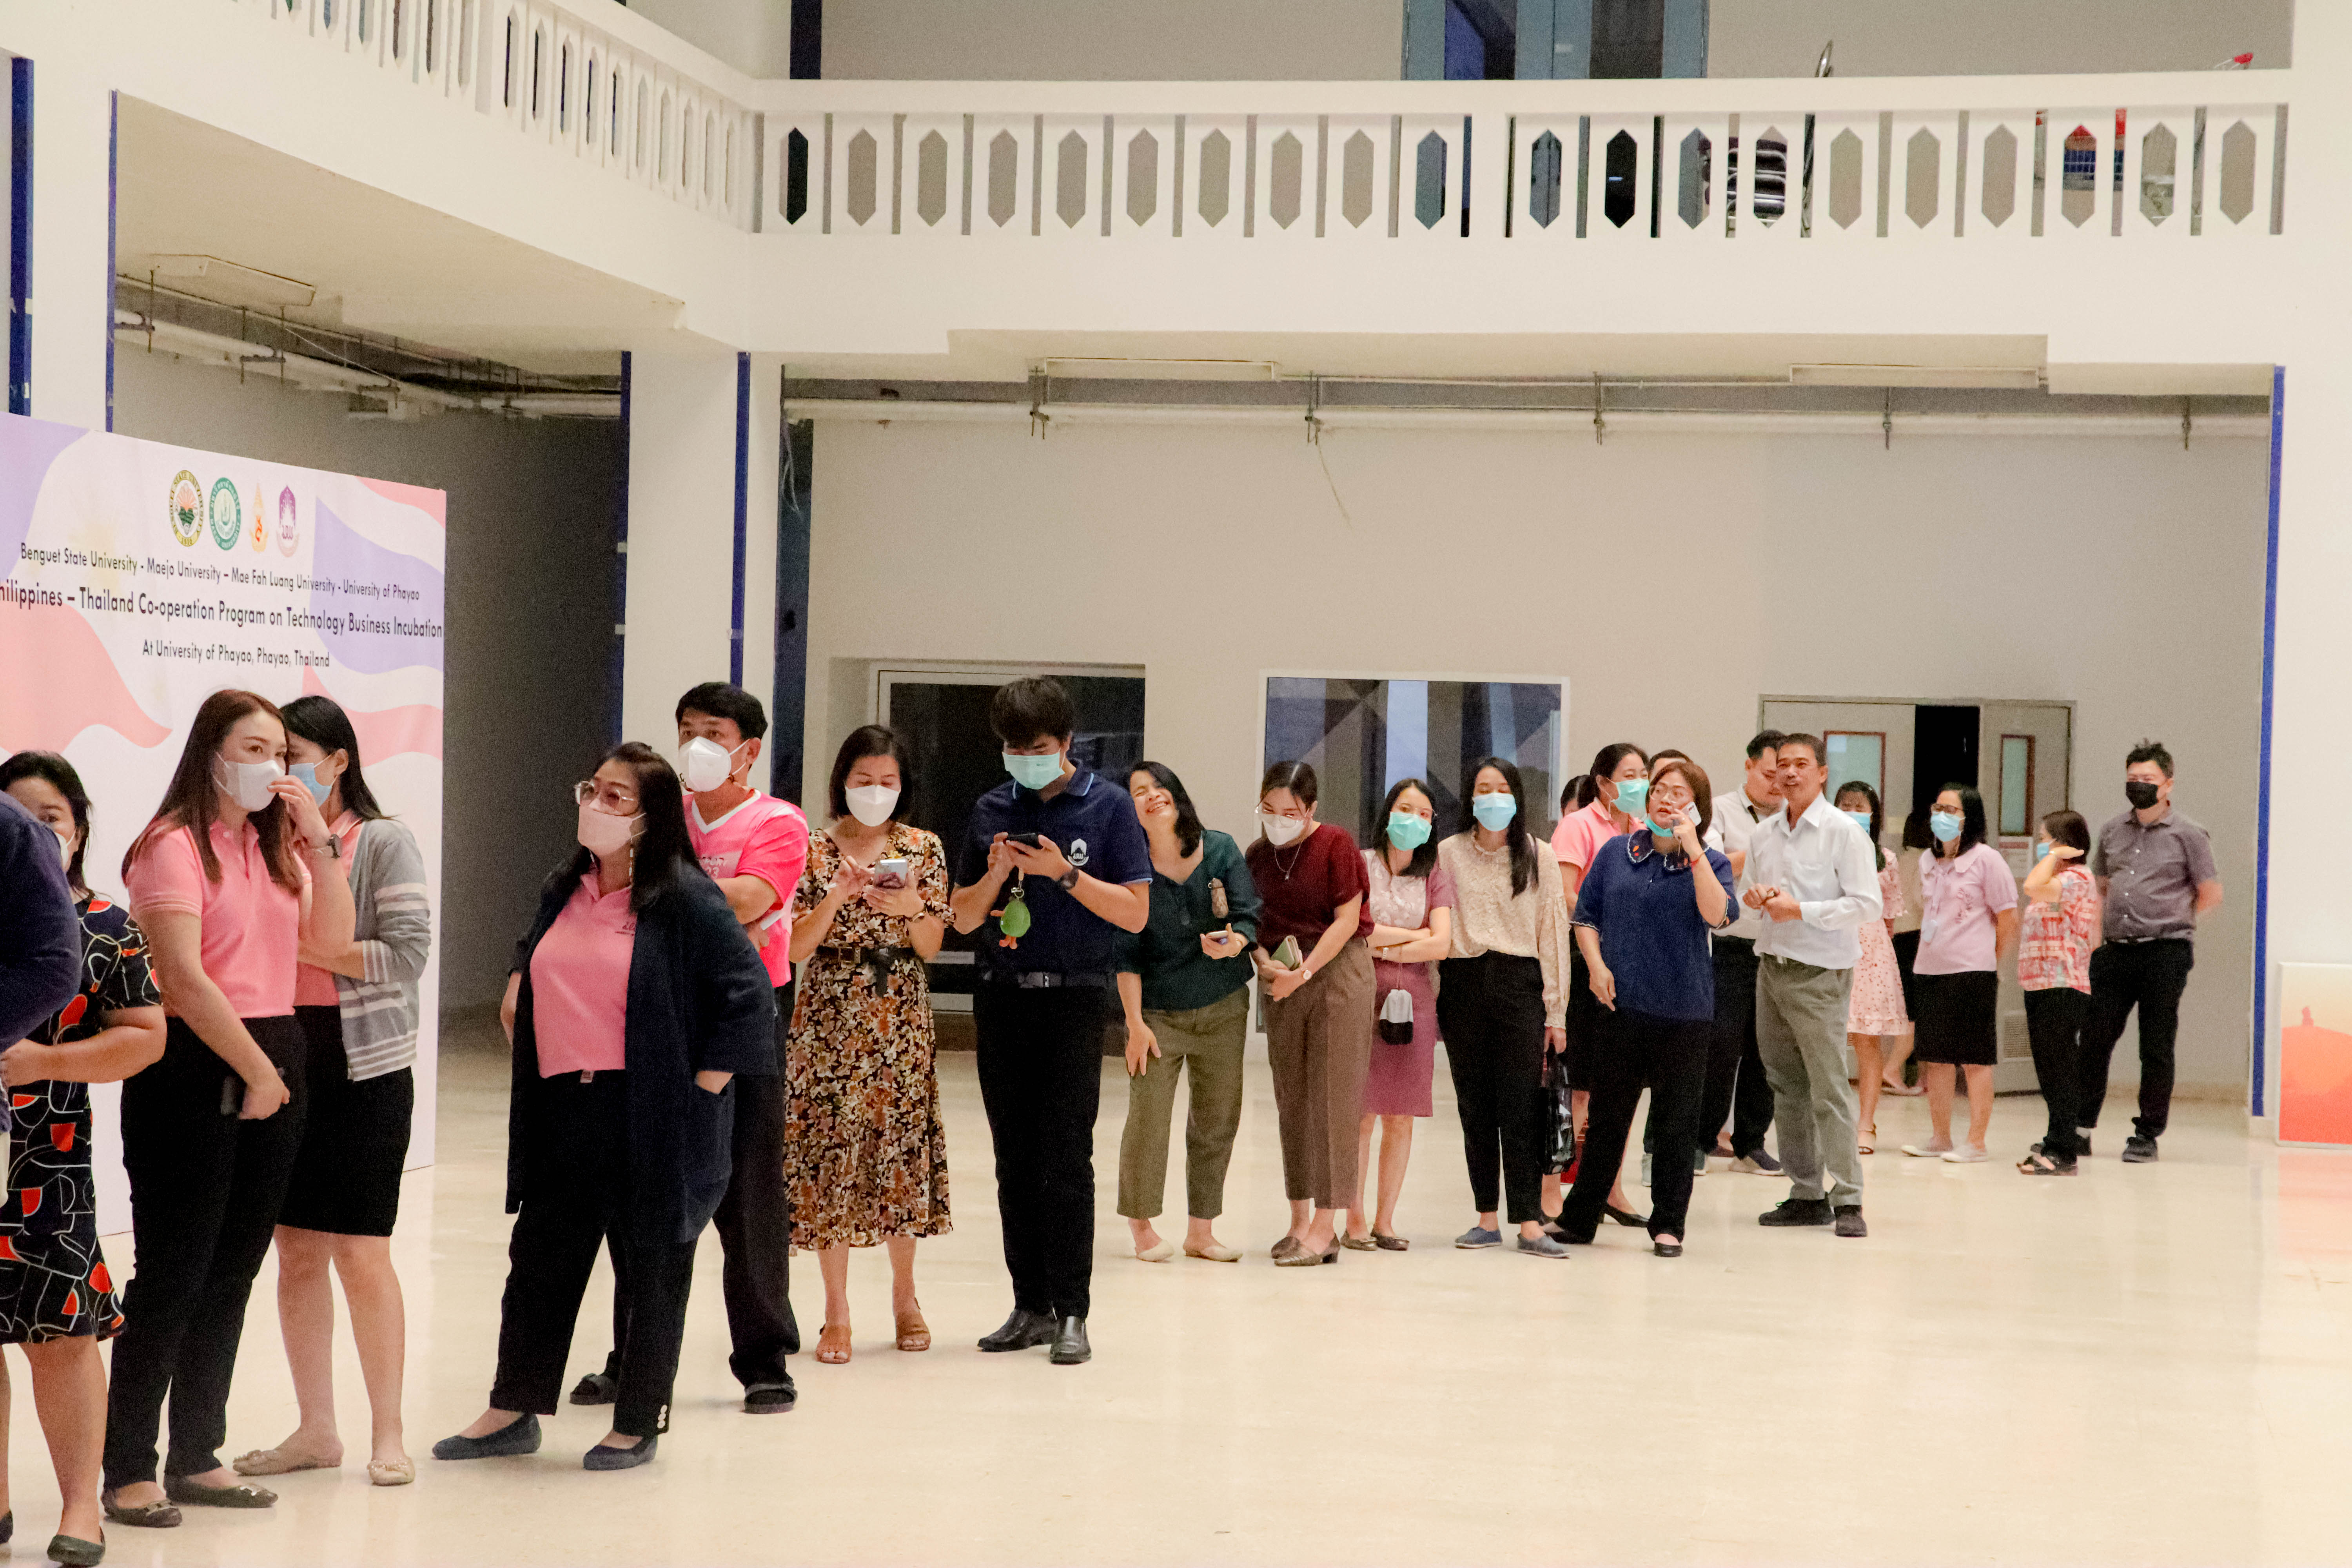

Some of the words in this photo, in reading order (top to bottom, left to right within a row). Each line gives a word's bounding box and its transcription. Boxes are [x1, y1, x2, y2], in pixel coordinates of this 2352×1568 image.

[21, 542, 60, 566] Benguet
[64, 548, 87, 566] State
[91, 551, 137, 575] University
[147, 557, 174, 579] Maejo
[178, 561, 220, 584] University
[232, 567, 249, 583] Mae
[252, 569, 266, 585] Fah
[270, 572, 293, 592] Luang
[297, 575, 335, 595] University
[344, 579, 379, 600] University
[383, 584, 390, 597] of
[393, 584, 419, 603] Phayao
[79, 586, 133, 613] Thailand
[139, 593, 214, 622] Co-operation
[219, 600, 265, 628] Program
[270, 612, 282, 626] on
[286, 606, 345, 635] Technology
[349, 612, 390, 634] Business
[394, 616, 441, 637] Incubation
[143, 639, 153, 655] At
[156, 640, 202, 663] University
[206, 644, 214, 660] of
[219, 644, 253, 666] Phayao,
[258, 647, 290, 668] Phayao,
[294, 650, 329, 667] Thailand
